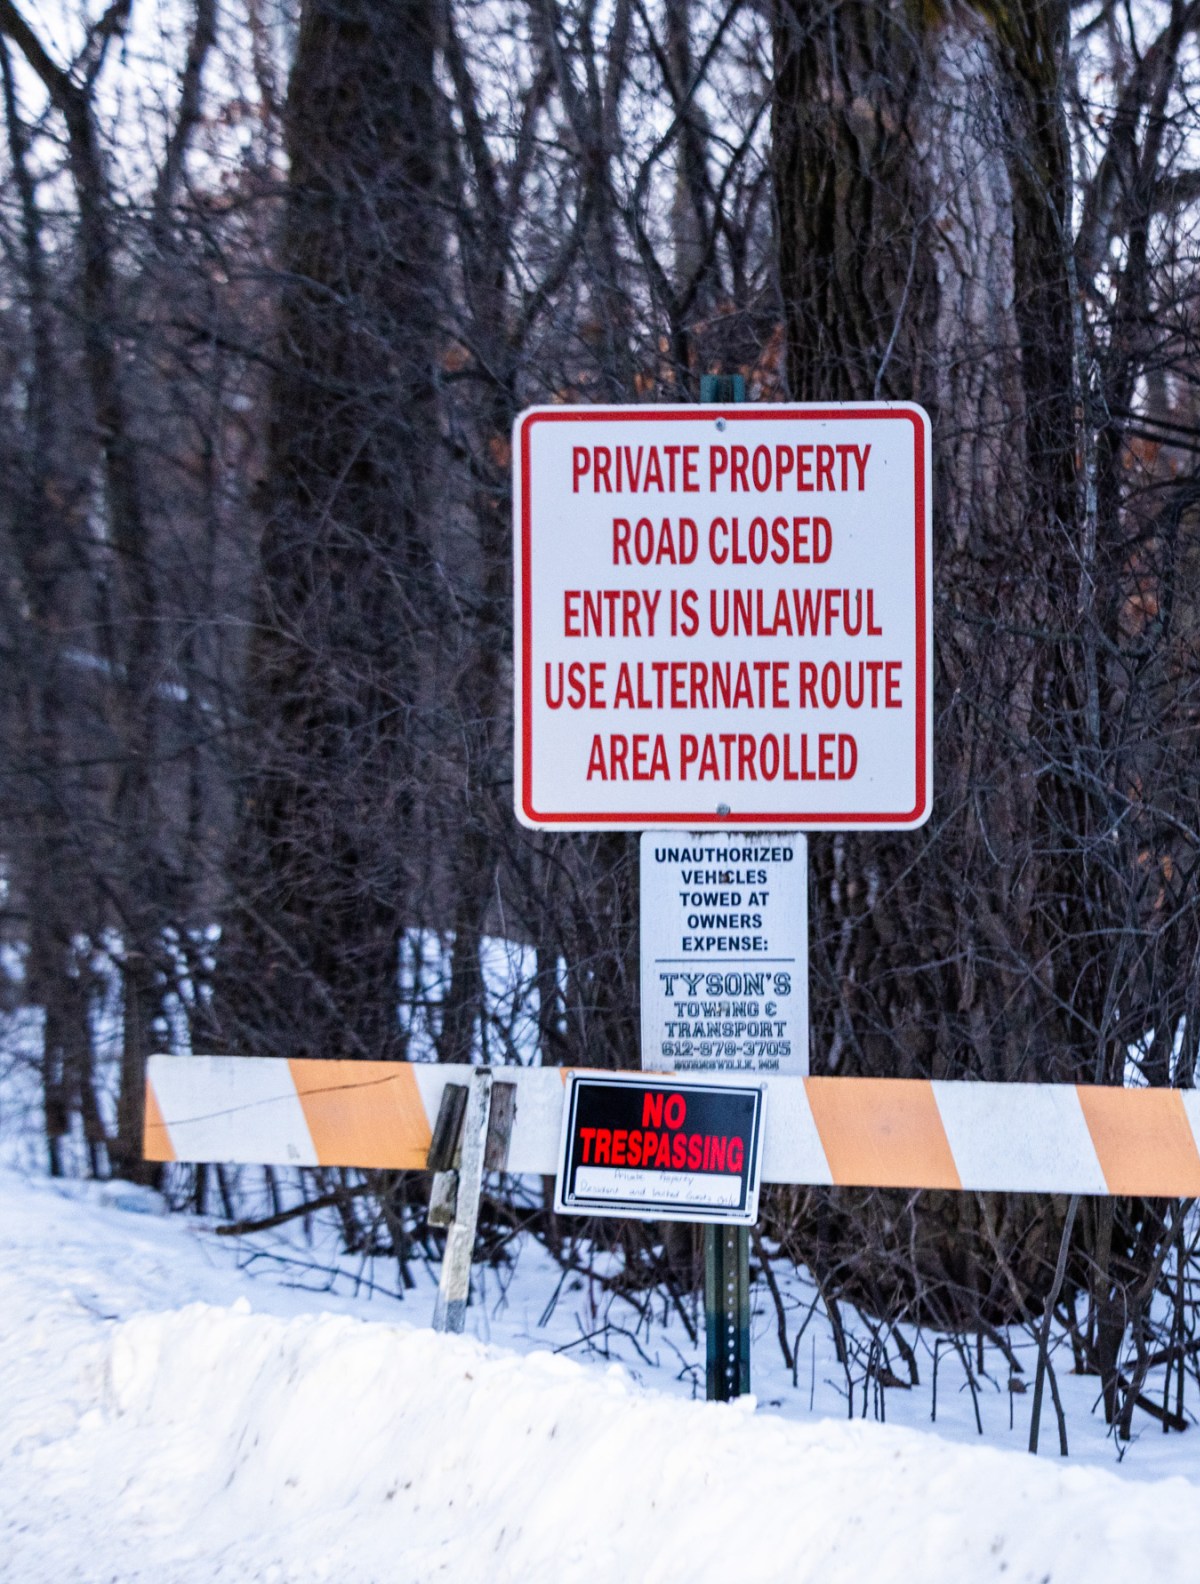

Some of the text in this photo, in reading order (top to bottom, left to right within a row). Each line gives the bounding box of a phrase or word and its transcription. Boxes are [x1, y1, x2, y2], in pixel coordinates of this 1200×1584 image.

[572, 444, 872, 493] PRIVATE PROPERTY
[612, 516, 833, 565] ROAD CLOSED
[563, 588, 883, 638] ENTRY IS UNLAWFUL
[544, 660, 903, 710] USE ALTERNATE ROUTE
[586, 733, 858, 781] AREA PATROLLED
[654, 847, 794, 864] UNAUTHORIZED
[681, 869, 768, 885] VEHICLES
[679, 891, 770, 907] TOWED AT
[687, 914, 763, 929] OWNERS
[682, 936, 769, 951] EXPENSE:
[659, 972, 792, 997] TYSON'S
[664, 1021, 787, 1038] TRANSPORT
[641, 1092, 687, 1129] NO
[579, 1127, 745, 1173] TRESPASSING
